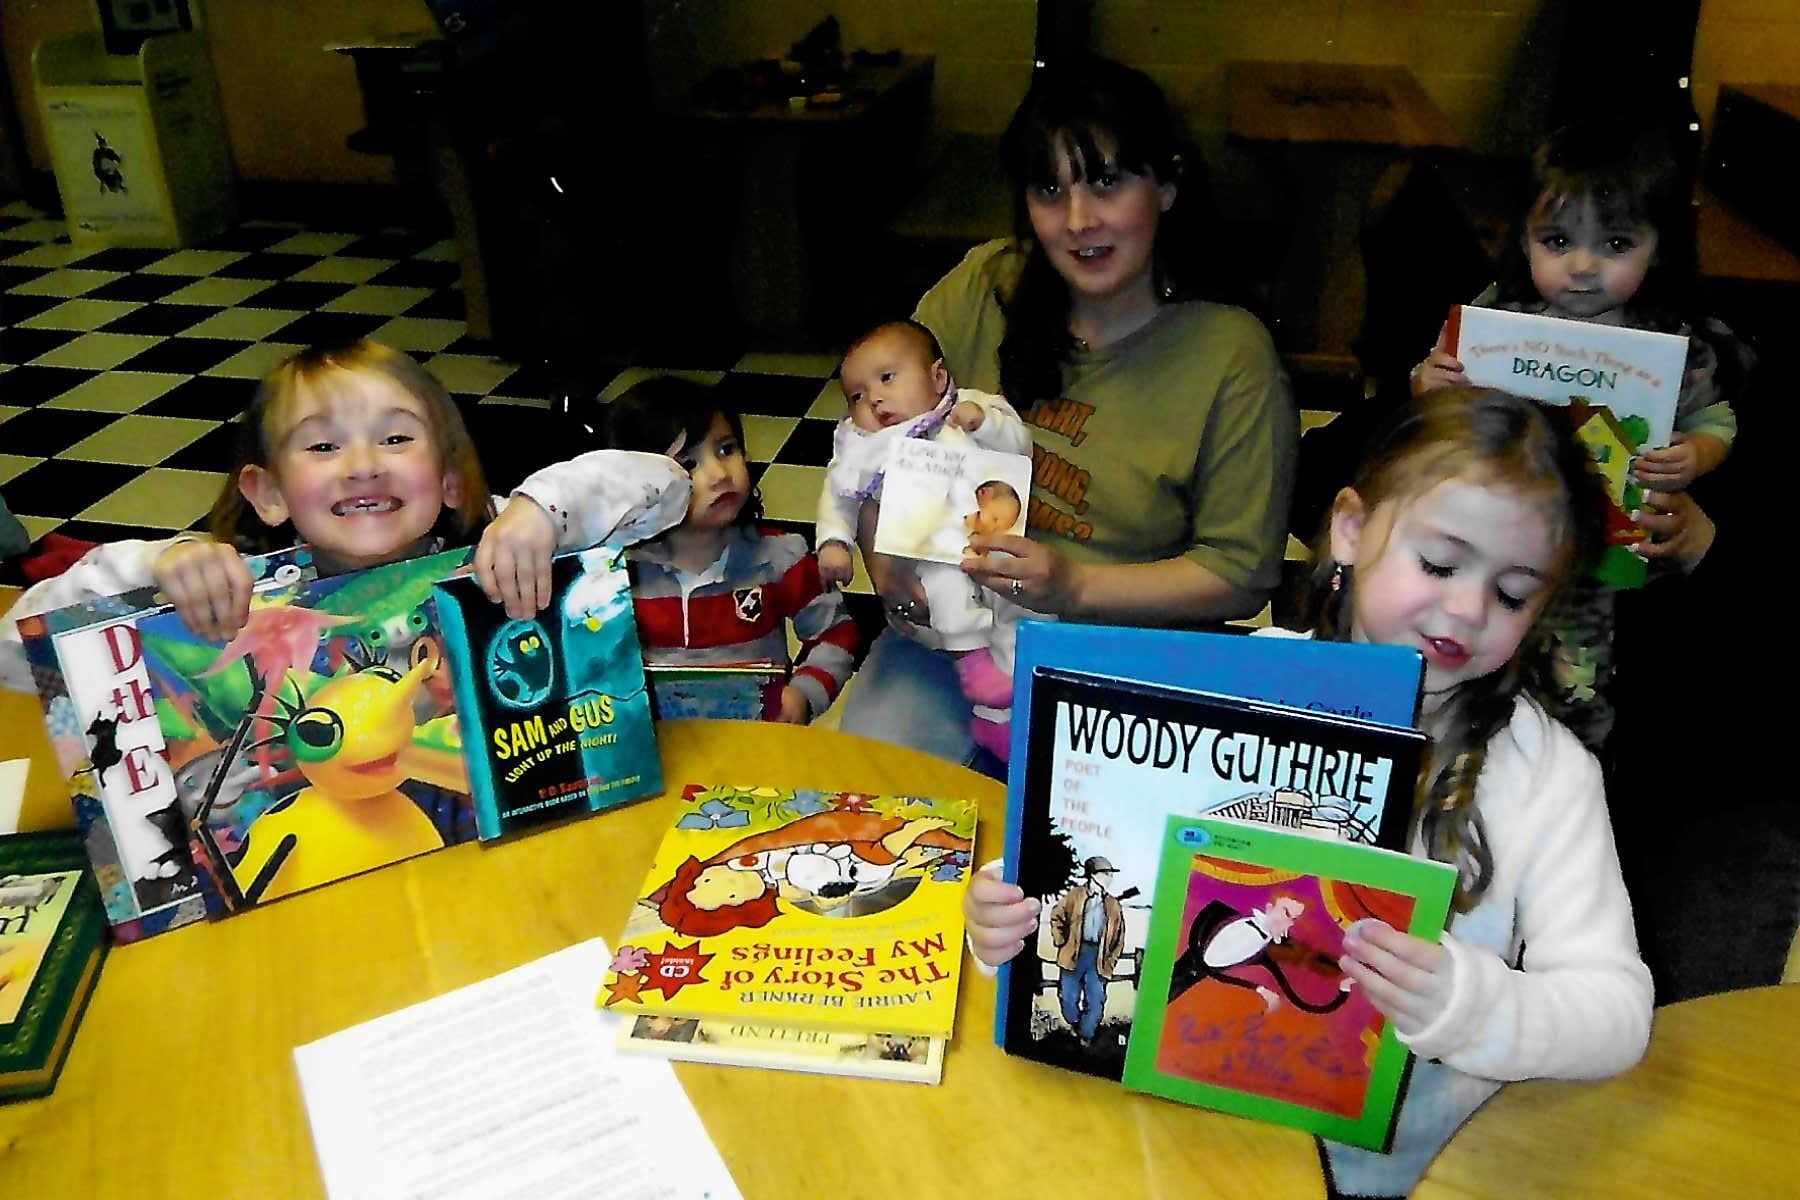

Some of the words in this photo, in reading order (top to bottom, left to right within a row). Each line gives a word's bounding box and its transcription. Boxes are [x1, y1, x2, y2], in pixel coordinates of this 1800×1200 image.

[1511, 356, 1618, 390] DRAGON
[493, 715, 548, 760] SAM
[548, 717, 568, 738] AND
[569, 694, 615, 733] GUS
[505, 757, 535, 783] LIGHT
[536, 748, 553, 762] UP
[554, 740, 577, 755] THE
[580, 733, 617, 749] NIGHT!
[1067, 701, 1200, 774] WOODY
[1211, 728, 1378, 806] GUTHRIE
[1065, 760, 1101, 778] POET
[1063, 779, 1081, 792] OF
[1063, 798, 1088, 814] THE
[1061, 817, 1113, 840] PEOPLE
[731, 943, 877, 968] Feelings
[891, 932, 948, 959] My
[659, 965, 690, 978] CD
[719, 970, 755, 992] of
[764, 966, 865, 992] Story
[878, 961, 950, 986] The
[740, 990, 844, 1008] BERKNER
[857, 989, 932, 1008] LAURIE
[730, 1025, 830, 1045] PRETEND
